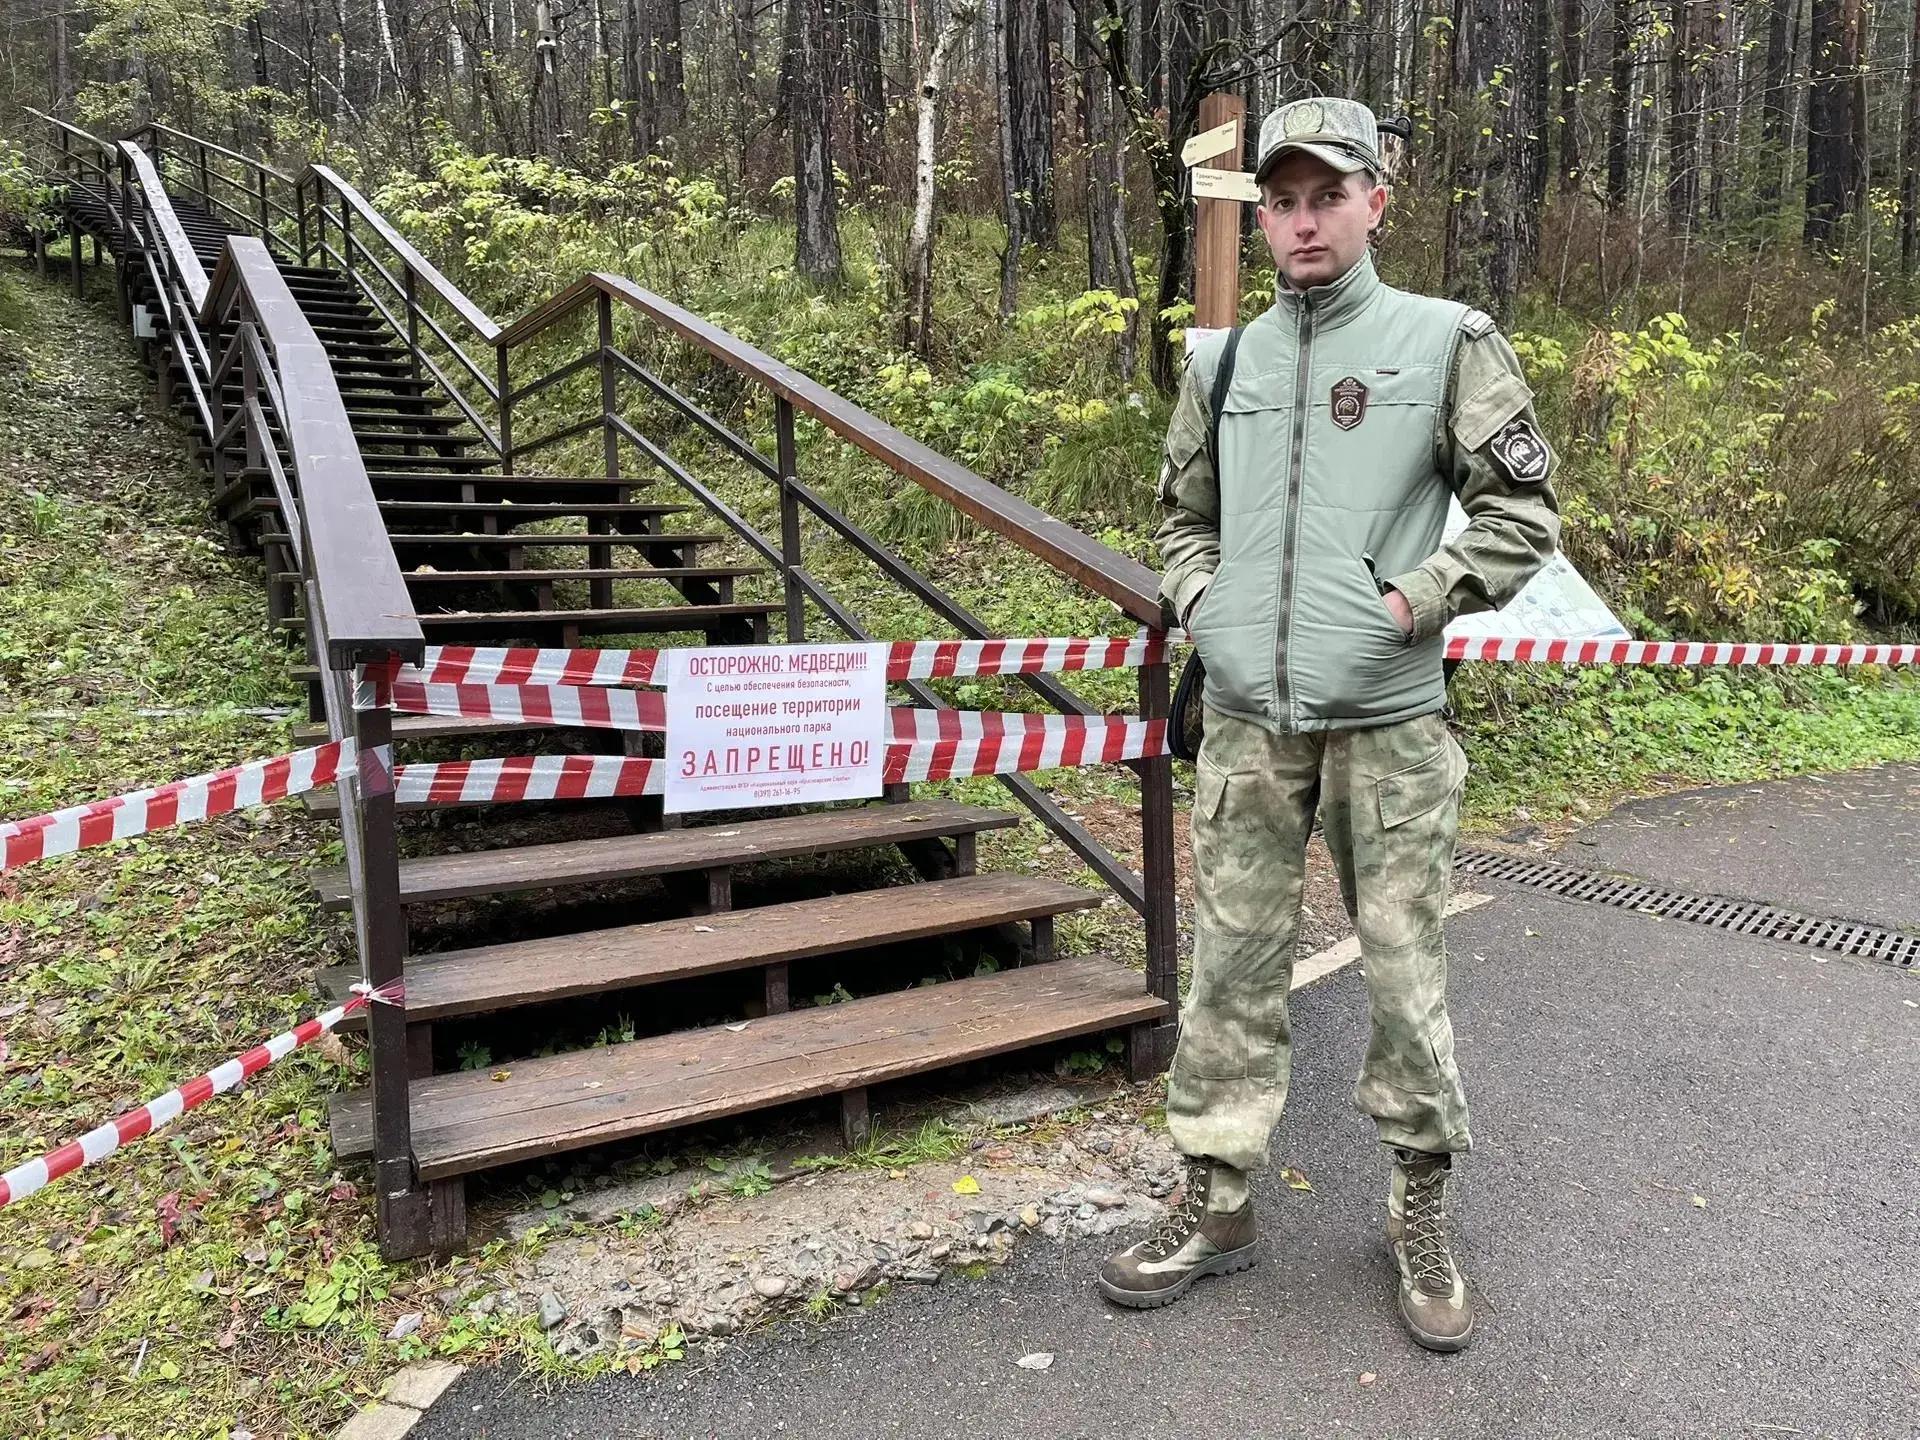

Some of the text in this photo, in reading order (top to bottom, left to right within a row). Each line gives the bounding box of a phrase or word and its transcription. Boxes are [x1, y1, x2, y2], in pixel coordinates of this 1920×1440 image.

[689, 652, 867, 675] ОСТОРОЖНО: МЕДВЕДИ!!!
[707, 678, 851, 693] С целью обеспечения безопасности,
[695, 698, 860, 719] посещение территории
[726, 721, 832, 738] национального парка
[682, 740, 869, 776] ЗАПРЕЩЕНО!
[772, 788, 800, 796] 261-16-95
